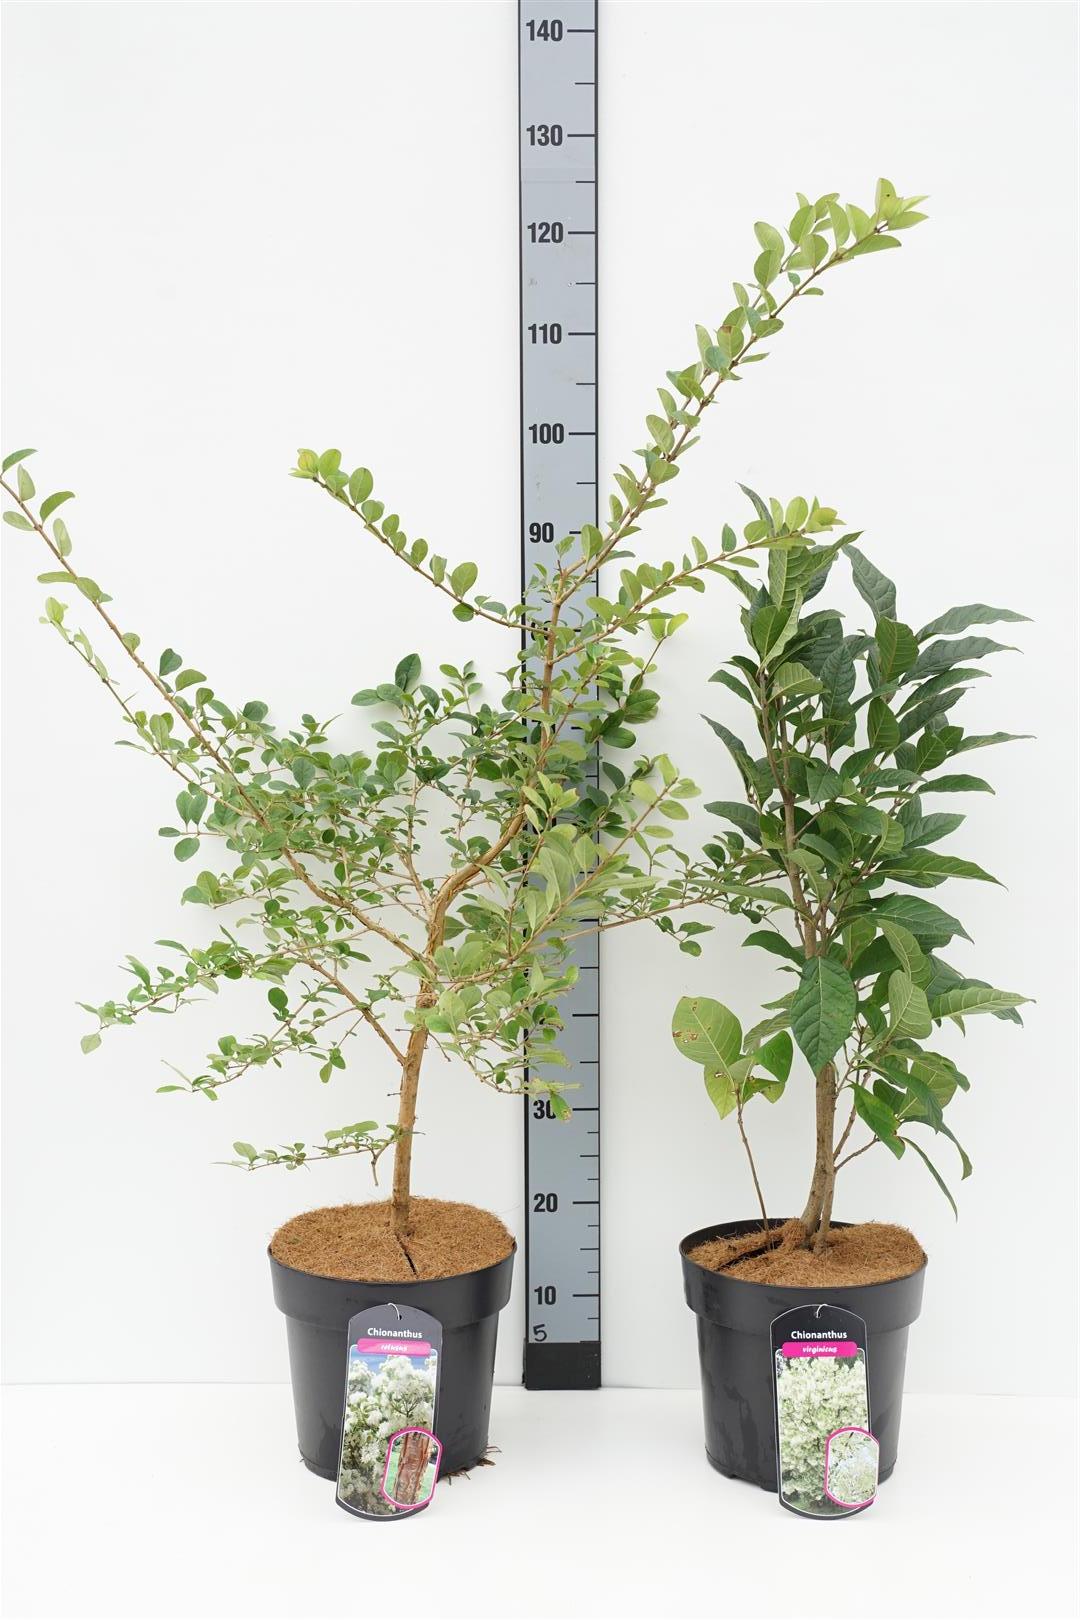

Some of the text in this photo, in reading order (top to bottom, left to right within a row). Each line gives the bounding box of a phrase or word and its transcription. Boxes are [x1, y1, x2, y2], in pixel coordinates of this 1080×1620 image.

[525, 20, 563, 41] 140
[526, 125, 563, 146] 130
[527, 222, 564, 243] 120
[527, 323, 563, 345] 110
[528, 423, 565, 445] 100
[529, 522, 554, 543] 90
[533, 1193, 558, 1212] 20
[534, 1286, 556, 1305] 10
[367, 1327, 423, 1339] Chionanthus
[533, 1324, 548, 1342] 5
[791, 1331, 847, 1340] Chionanthus
